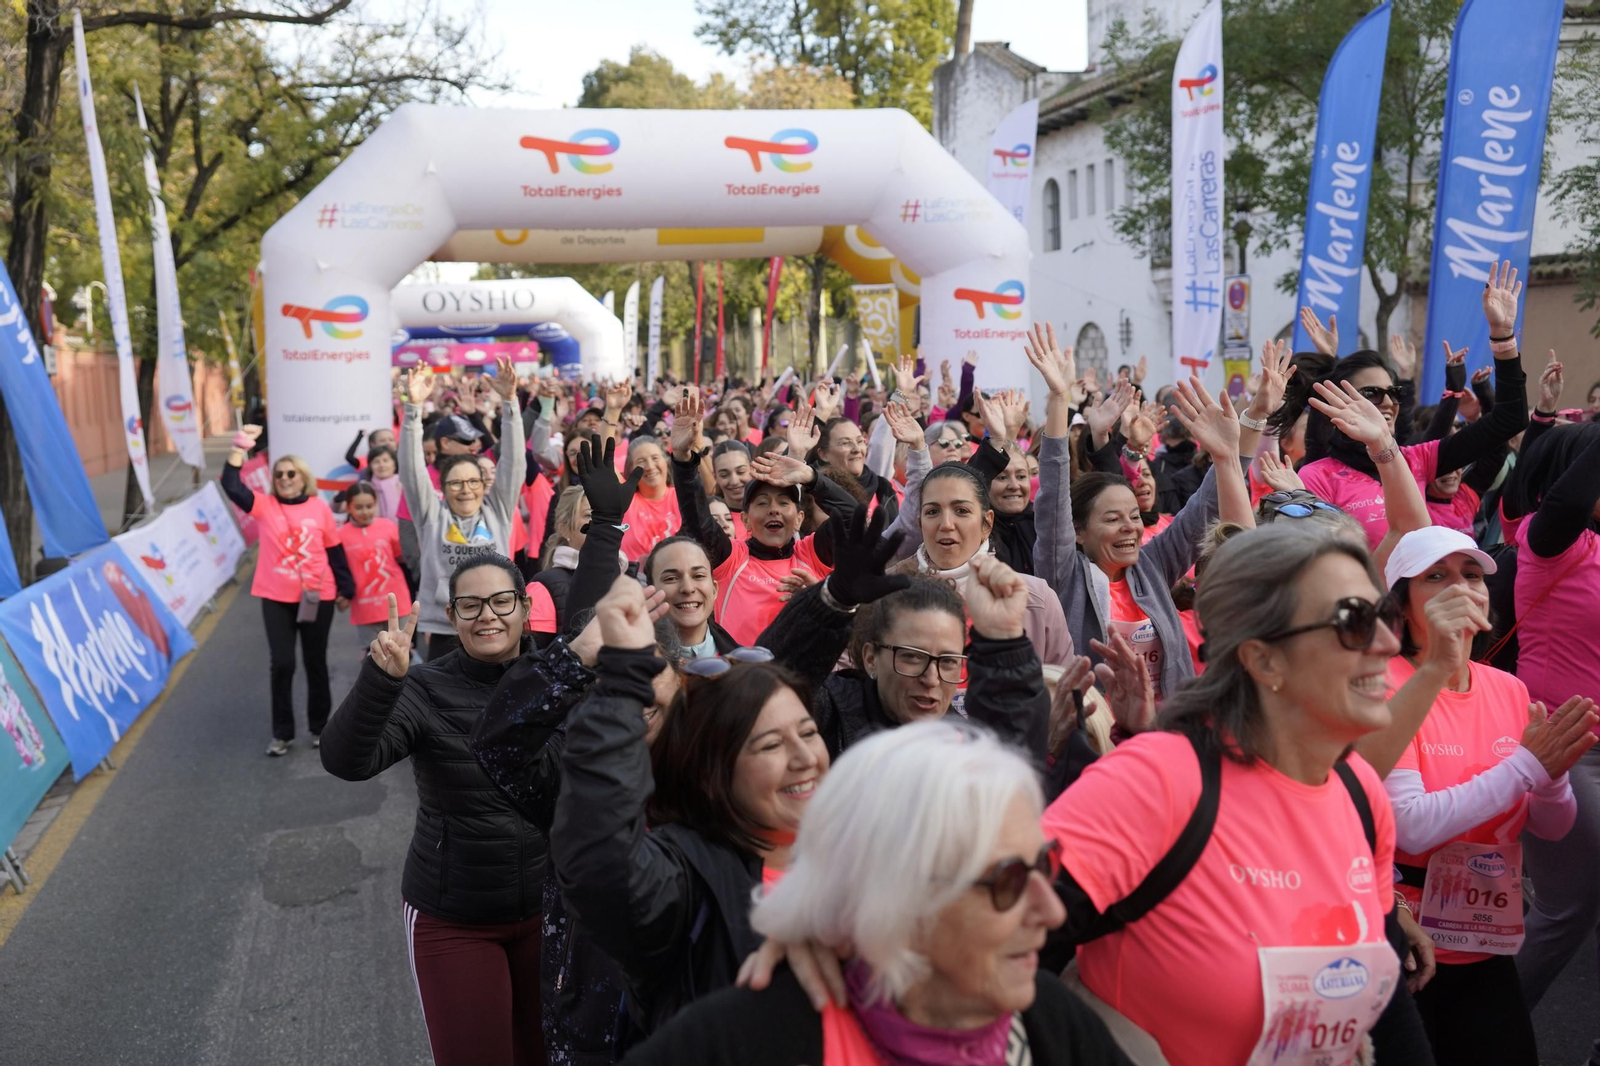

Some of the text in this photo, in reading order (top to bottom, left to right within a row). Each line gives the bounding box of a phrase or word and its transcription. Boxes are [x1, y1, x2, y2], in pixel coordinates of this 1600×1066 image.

[725, 182, 820, 198] TotalEnergies
[1444, 84, 1533, 283] Marlene
[521, 184, 622, 200] TotalEnergies
[1200, 150, 1221, 275] LasCarreras
[1305, 141, 1367, 312] Marlene
[560, 234, 625, 247] de Deportes
[422, 288, 535, 314] OYSHO
[281, 347, 370, 363] TotalEnergies
[1347, 498, 1374, 511] Sports
[1420, 742, 1464, 757] OYSHO
[1229, 863, 1301, 890] OYSHO
[1466, 888, 1508, 909] 016
[1437, 920, 1463, 930] CARRERA
[1472, 913, 1493, 923] 5056
[1431, 933, 1469, 945] OYSHO
[1311, 1018, 1358, 1049] 016
